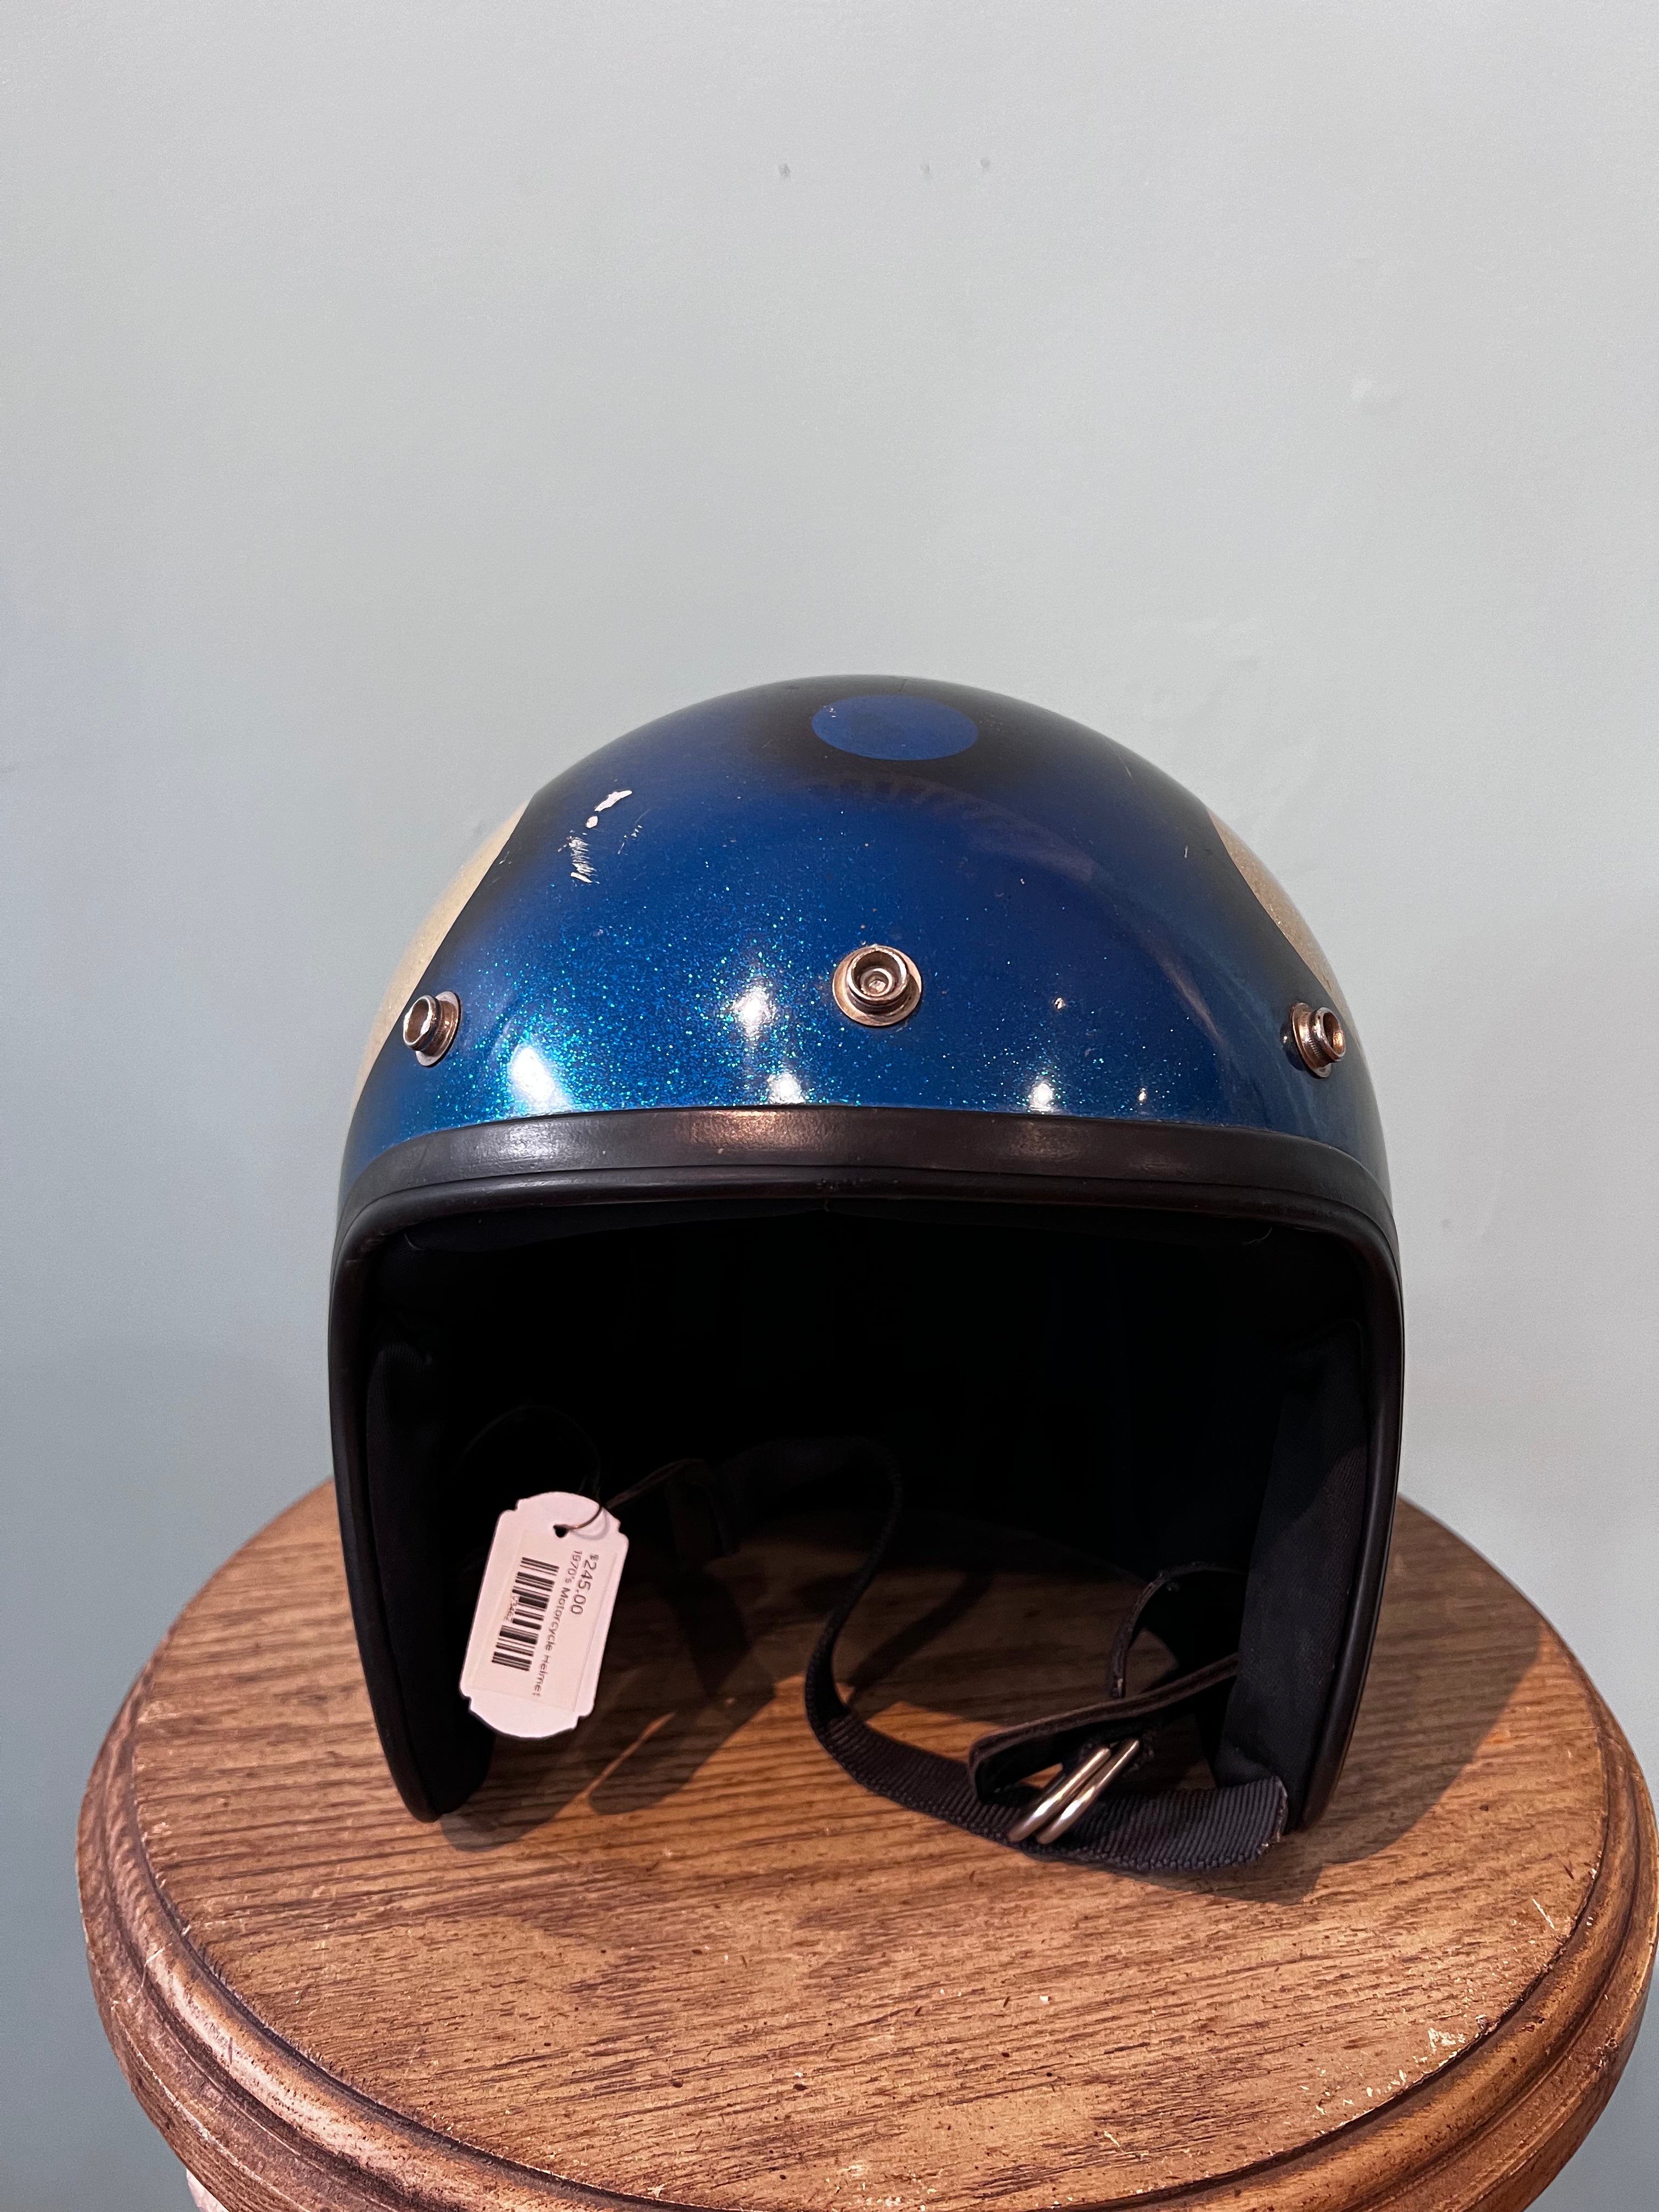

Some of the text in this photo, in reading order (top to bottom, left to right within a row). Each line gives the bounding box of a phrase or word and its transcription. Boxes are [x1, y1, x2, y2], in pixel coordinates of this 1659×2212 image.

[571, 1554, 599, 1615] $245.00
[545, 1587, 571, 1651] Motorcycle
[532, 1655, 551, 1697] Helmet
